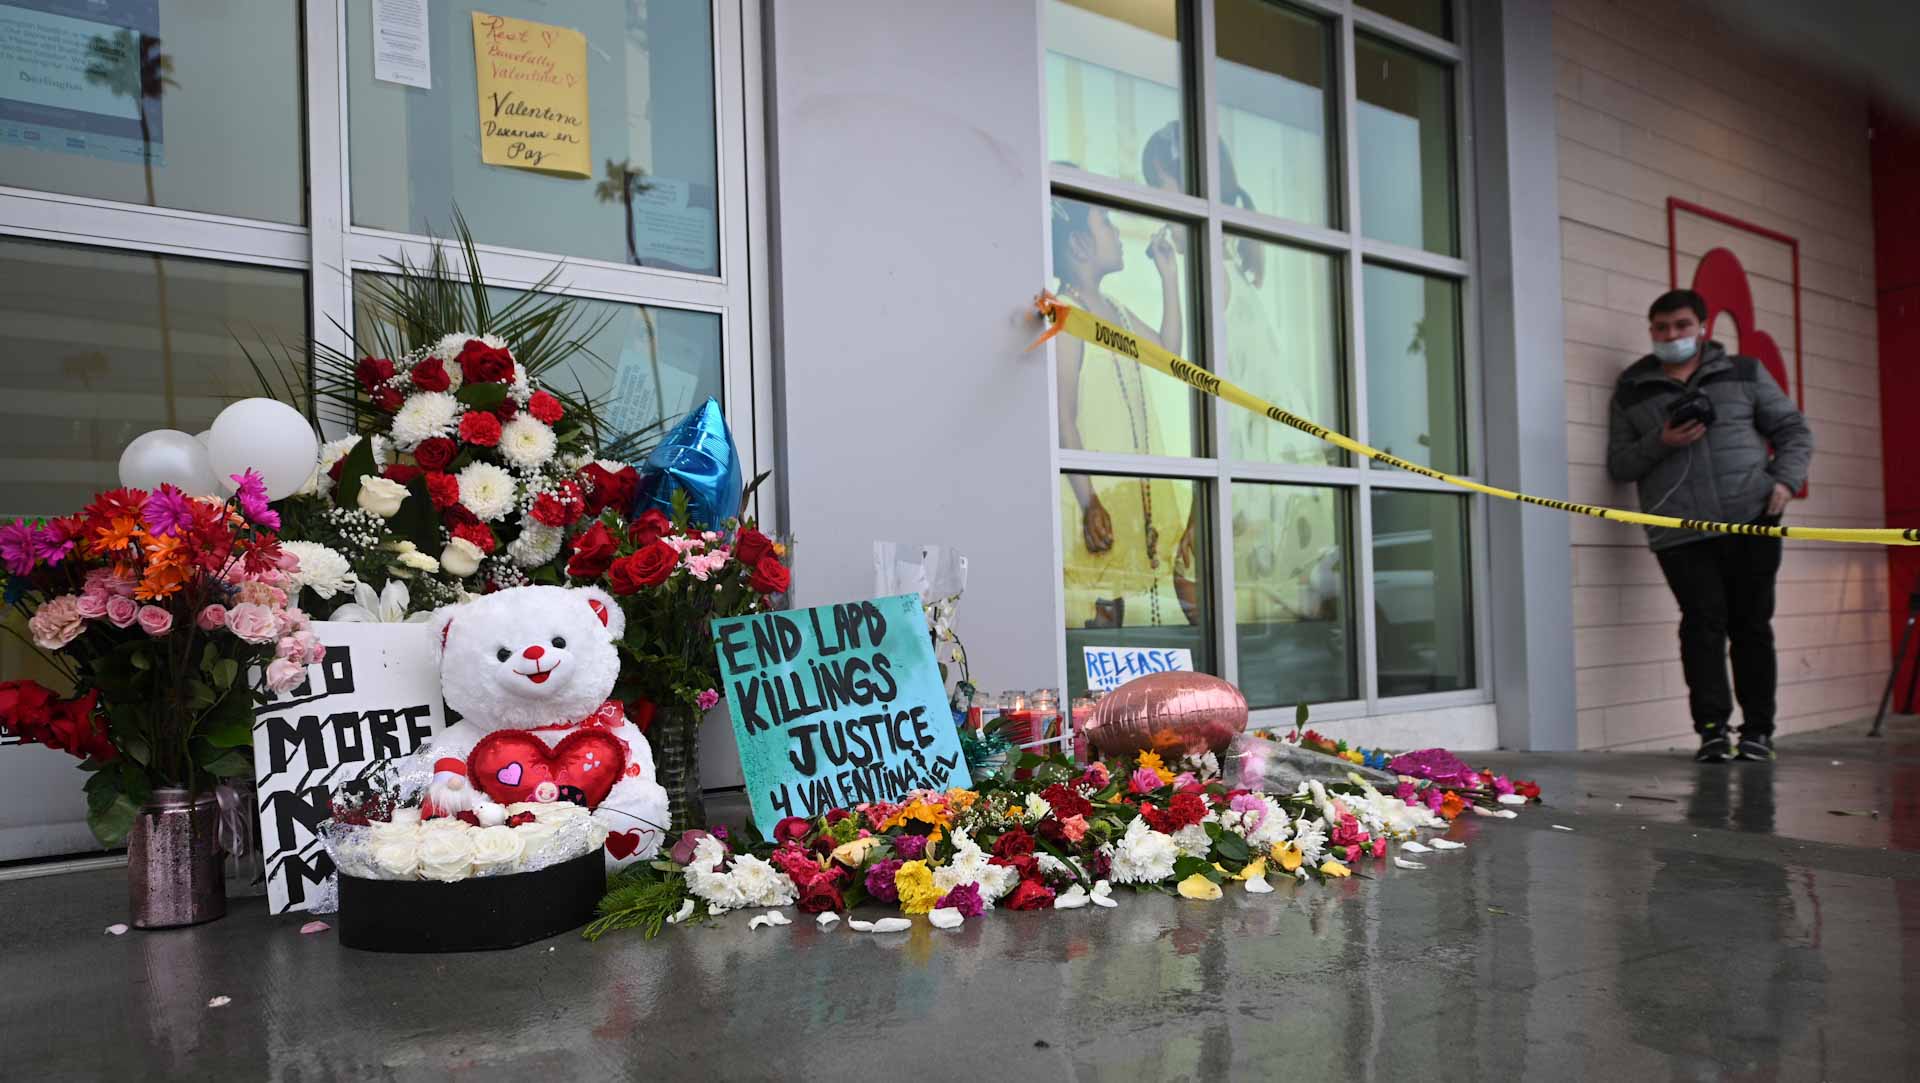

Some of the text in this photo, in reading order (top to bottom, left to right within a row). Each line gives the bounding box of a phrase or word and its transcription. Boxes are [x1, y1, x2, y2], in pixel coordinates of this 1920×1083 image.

[481, 15, 529, 43] Rest
[488, 91, 584, 127] Valentina
[553, 132, 581, 144] en
[507, 142, 550, 166] Paz
[718, 601, 888, 675] END LAPD
[1086, 650, 1183, 678] RELEASE
[1096, 676, 1121, 686] THE
[265, 704, 432, 774] MORE
[788, 704, 936, 777] JUSTICE
[770, 783, 794, 818] 4
